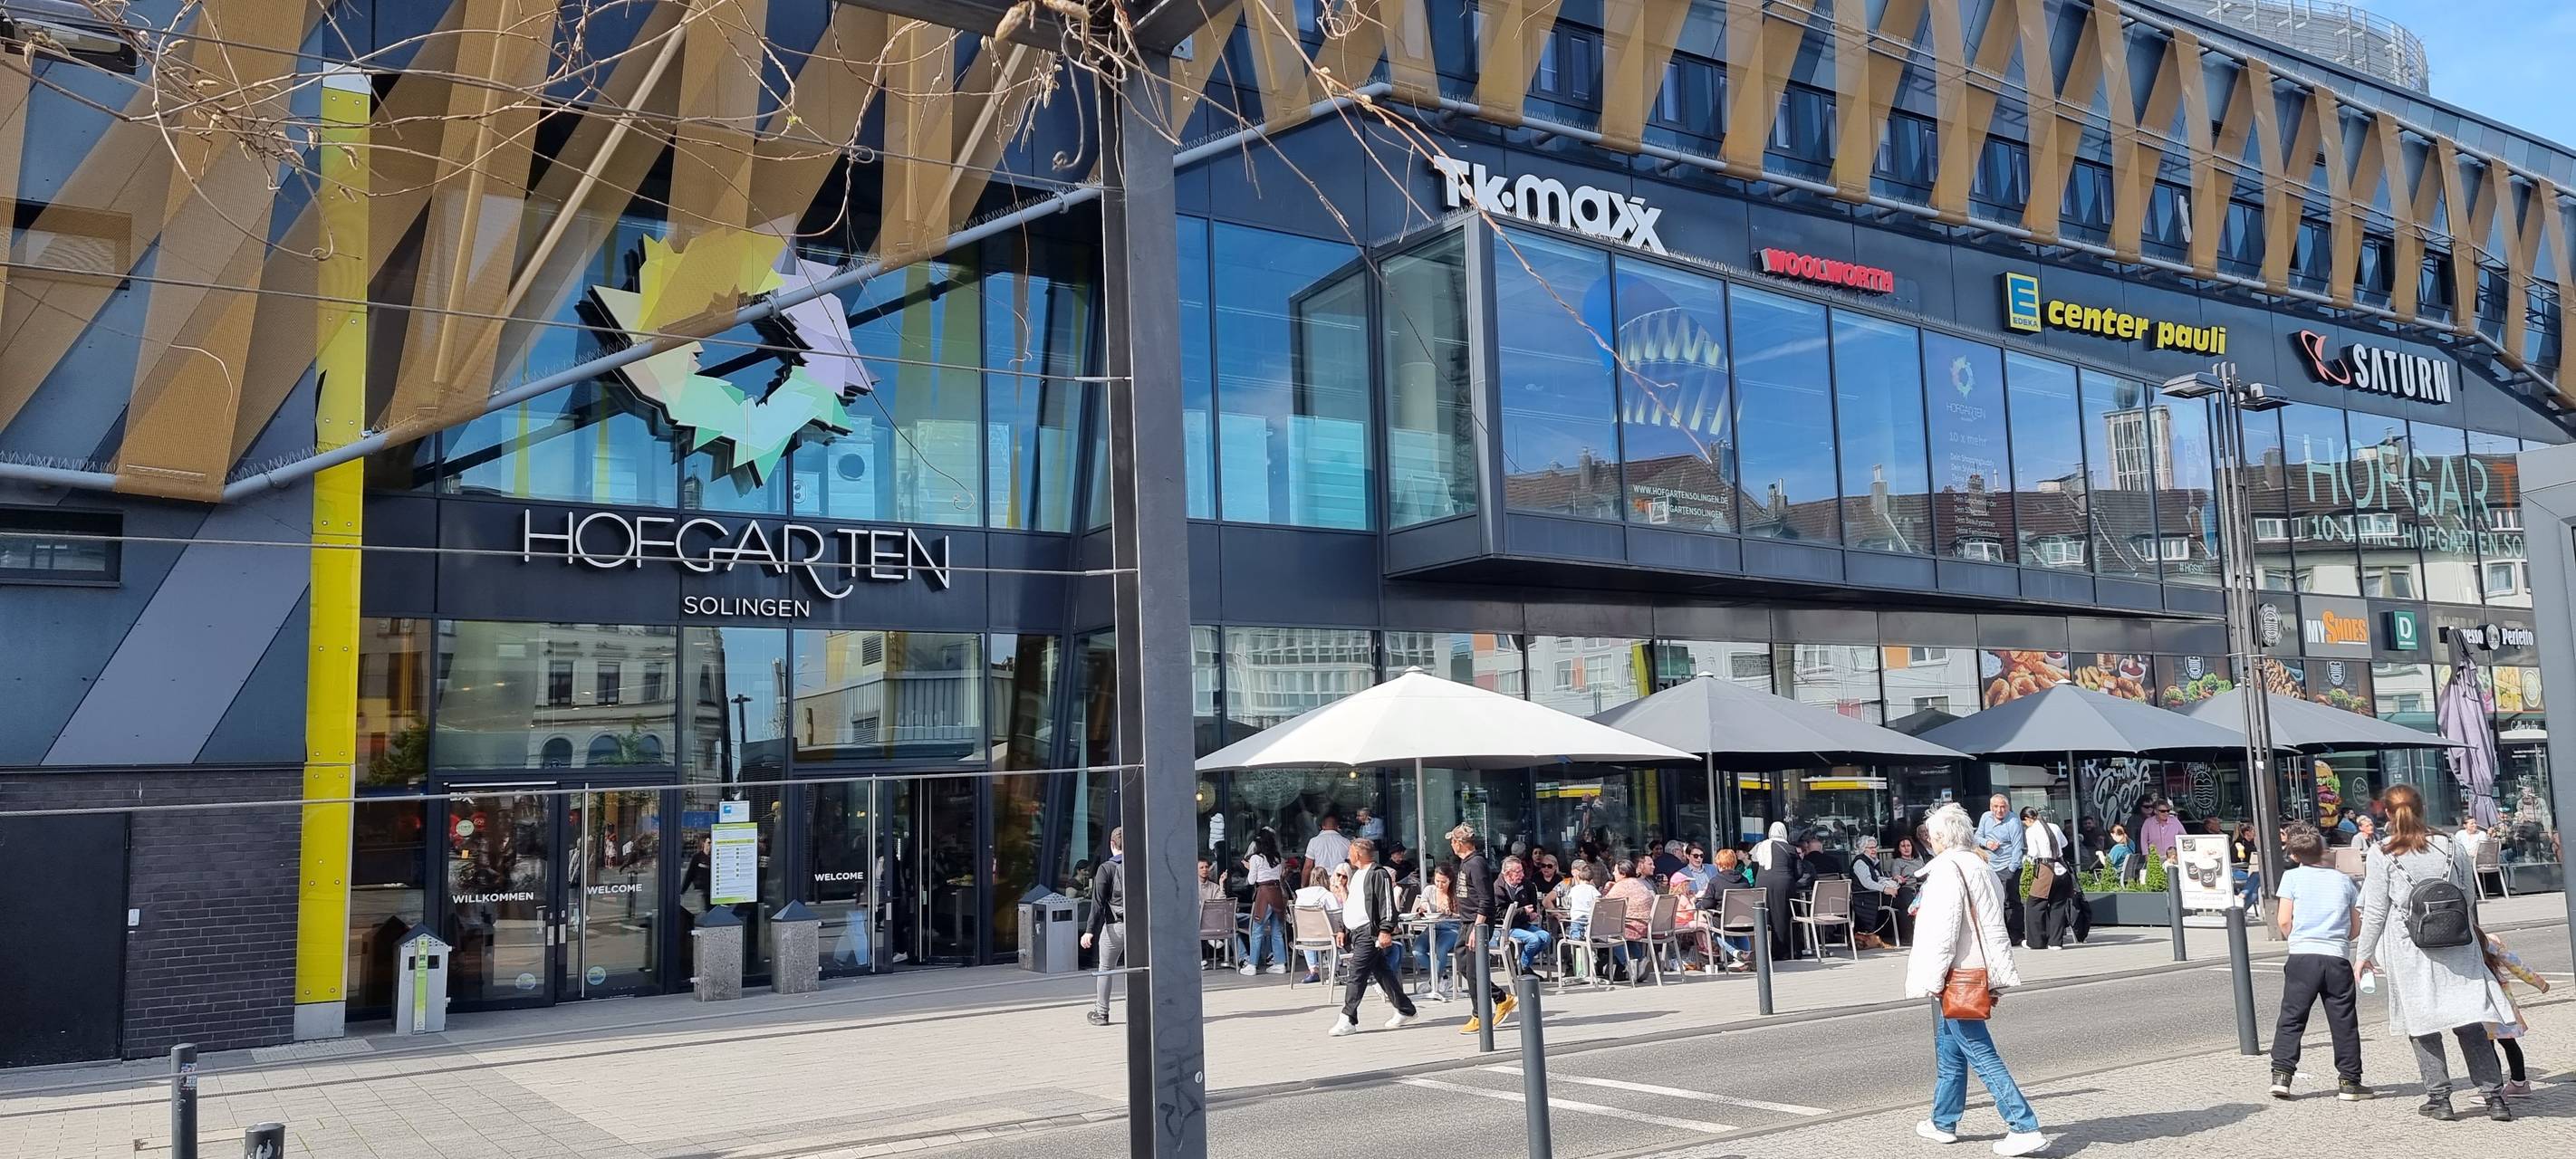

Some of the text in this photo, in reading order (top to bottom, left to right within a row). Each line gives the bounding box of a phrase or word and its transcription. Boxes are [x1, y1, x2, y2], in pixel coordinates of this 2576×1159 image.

[1761, 247, 1894, 293] WOOLWORTH
[2011, 277, 2226, 354] E center pauli
[2013, 317, 2038, 329] EDEKA
[2352, 343, 2451, 403] SATURN
[2312, 514, 2334, 541] 10
[2402, 523, 2500, 557] HOFGARTEN
[524, 509, 950, 599] HOFGARTEN
[684, 595, 811, 618] SOLINGEN
[2502, 628, 2534, 646] Perfetto
[814, 872, 864, 881] WELCOME
[452, 892, 534, 904] WILLKOMMEN
[587, 883, 643, 895] WELCOME
